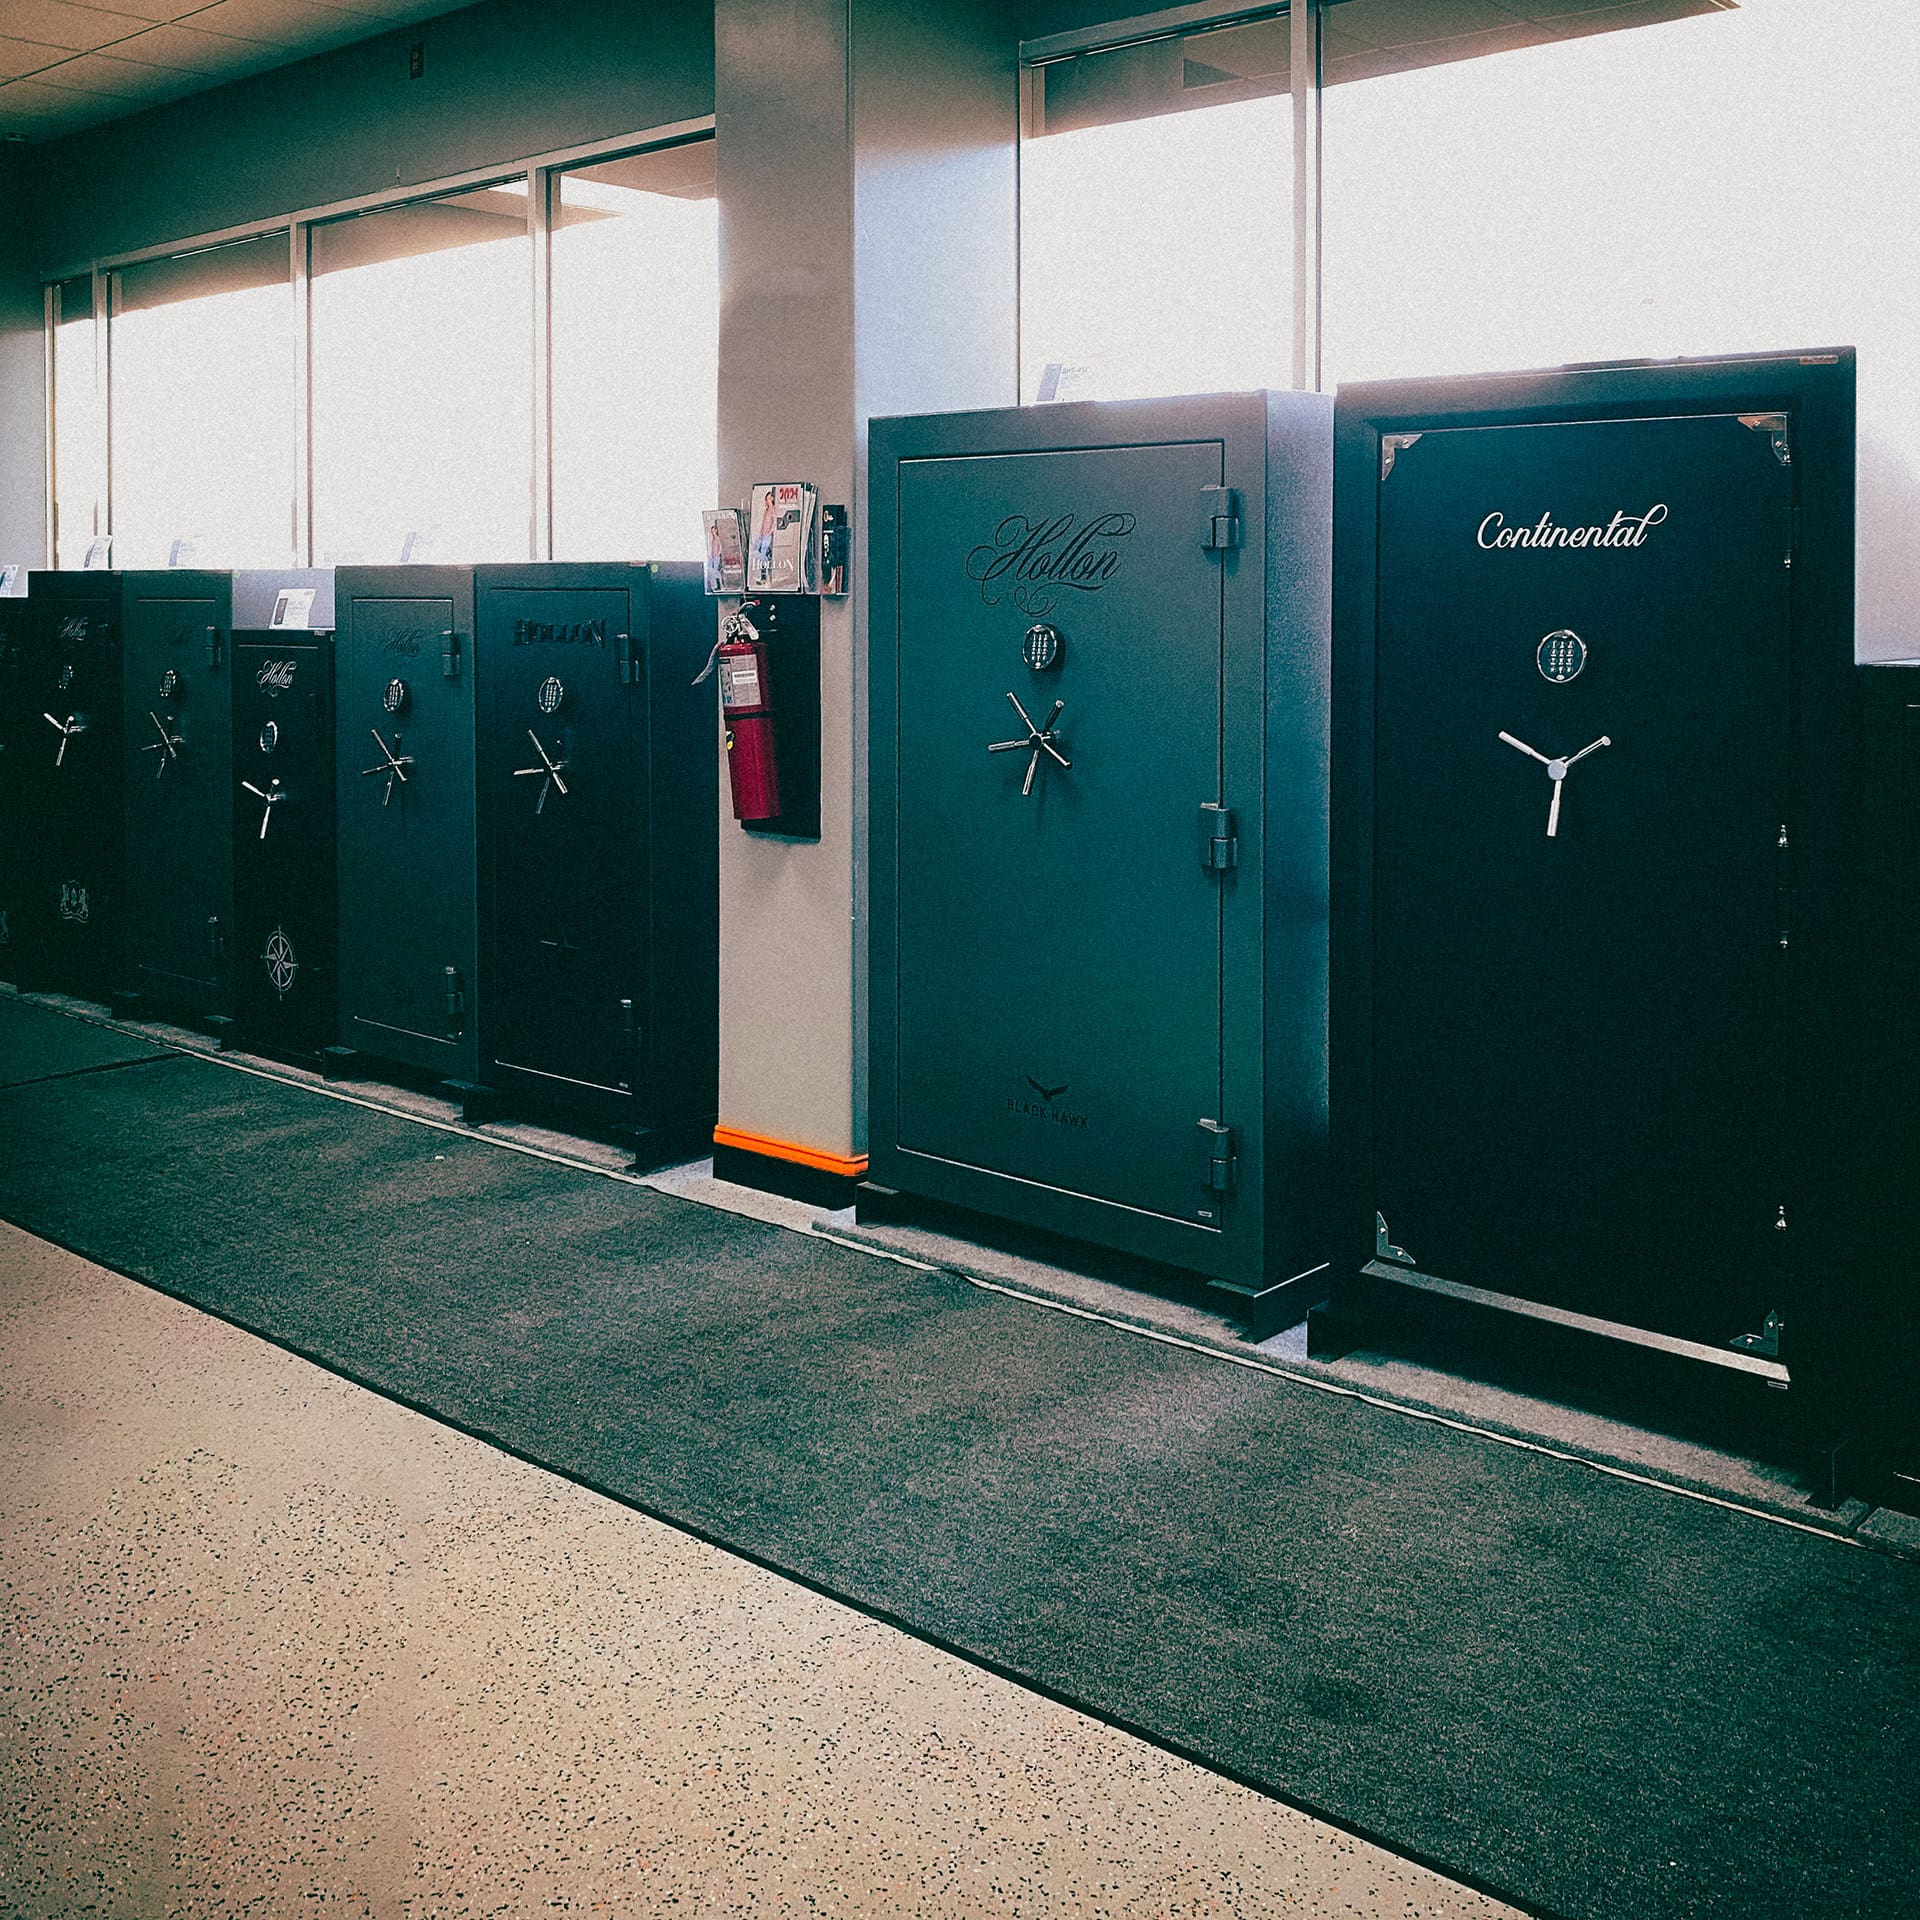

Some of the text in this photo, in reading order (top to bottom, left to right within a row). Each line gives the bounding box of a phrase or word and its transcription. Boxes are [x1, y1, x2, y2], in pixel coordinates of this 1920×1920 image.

[1477, 503, 1668, 549] Continental
[751, 558, 794, 571] HOLLON
[966, 512, 1137, 618] Hollon
[256, 659, 297, 697] Hollon
